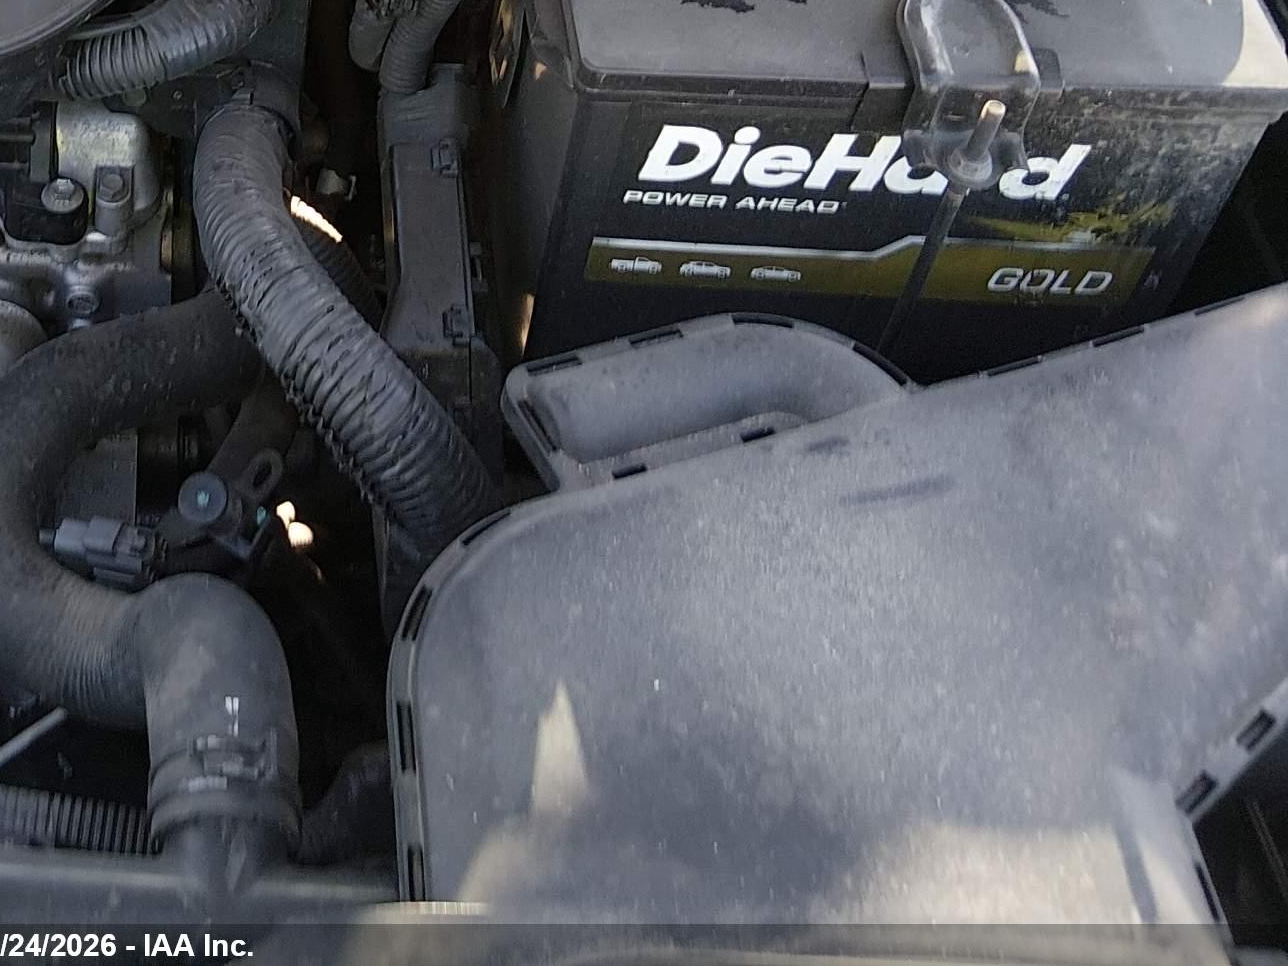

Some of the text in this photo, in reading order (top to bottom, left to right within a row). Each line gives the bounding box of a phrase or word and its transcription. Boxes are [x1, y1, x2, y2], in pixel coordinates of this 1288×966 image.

[638, 124, 1092, 201] DieHad
[623, 189, 842, 215] POWER AHEAD
[987, 266, 1113, 296] GOLD
